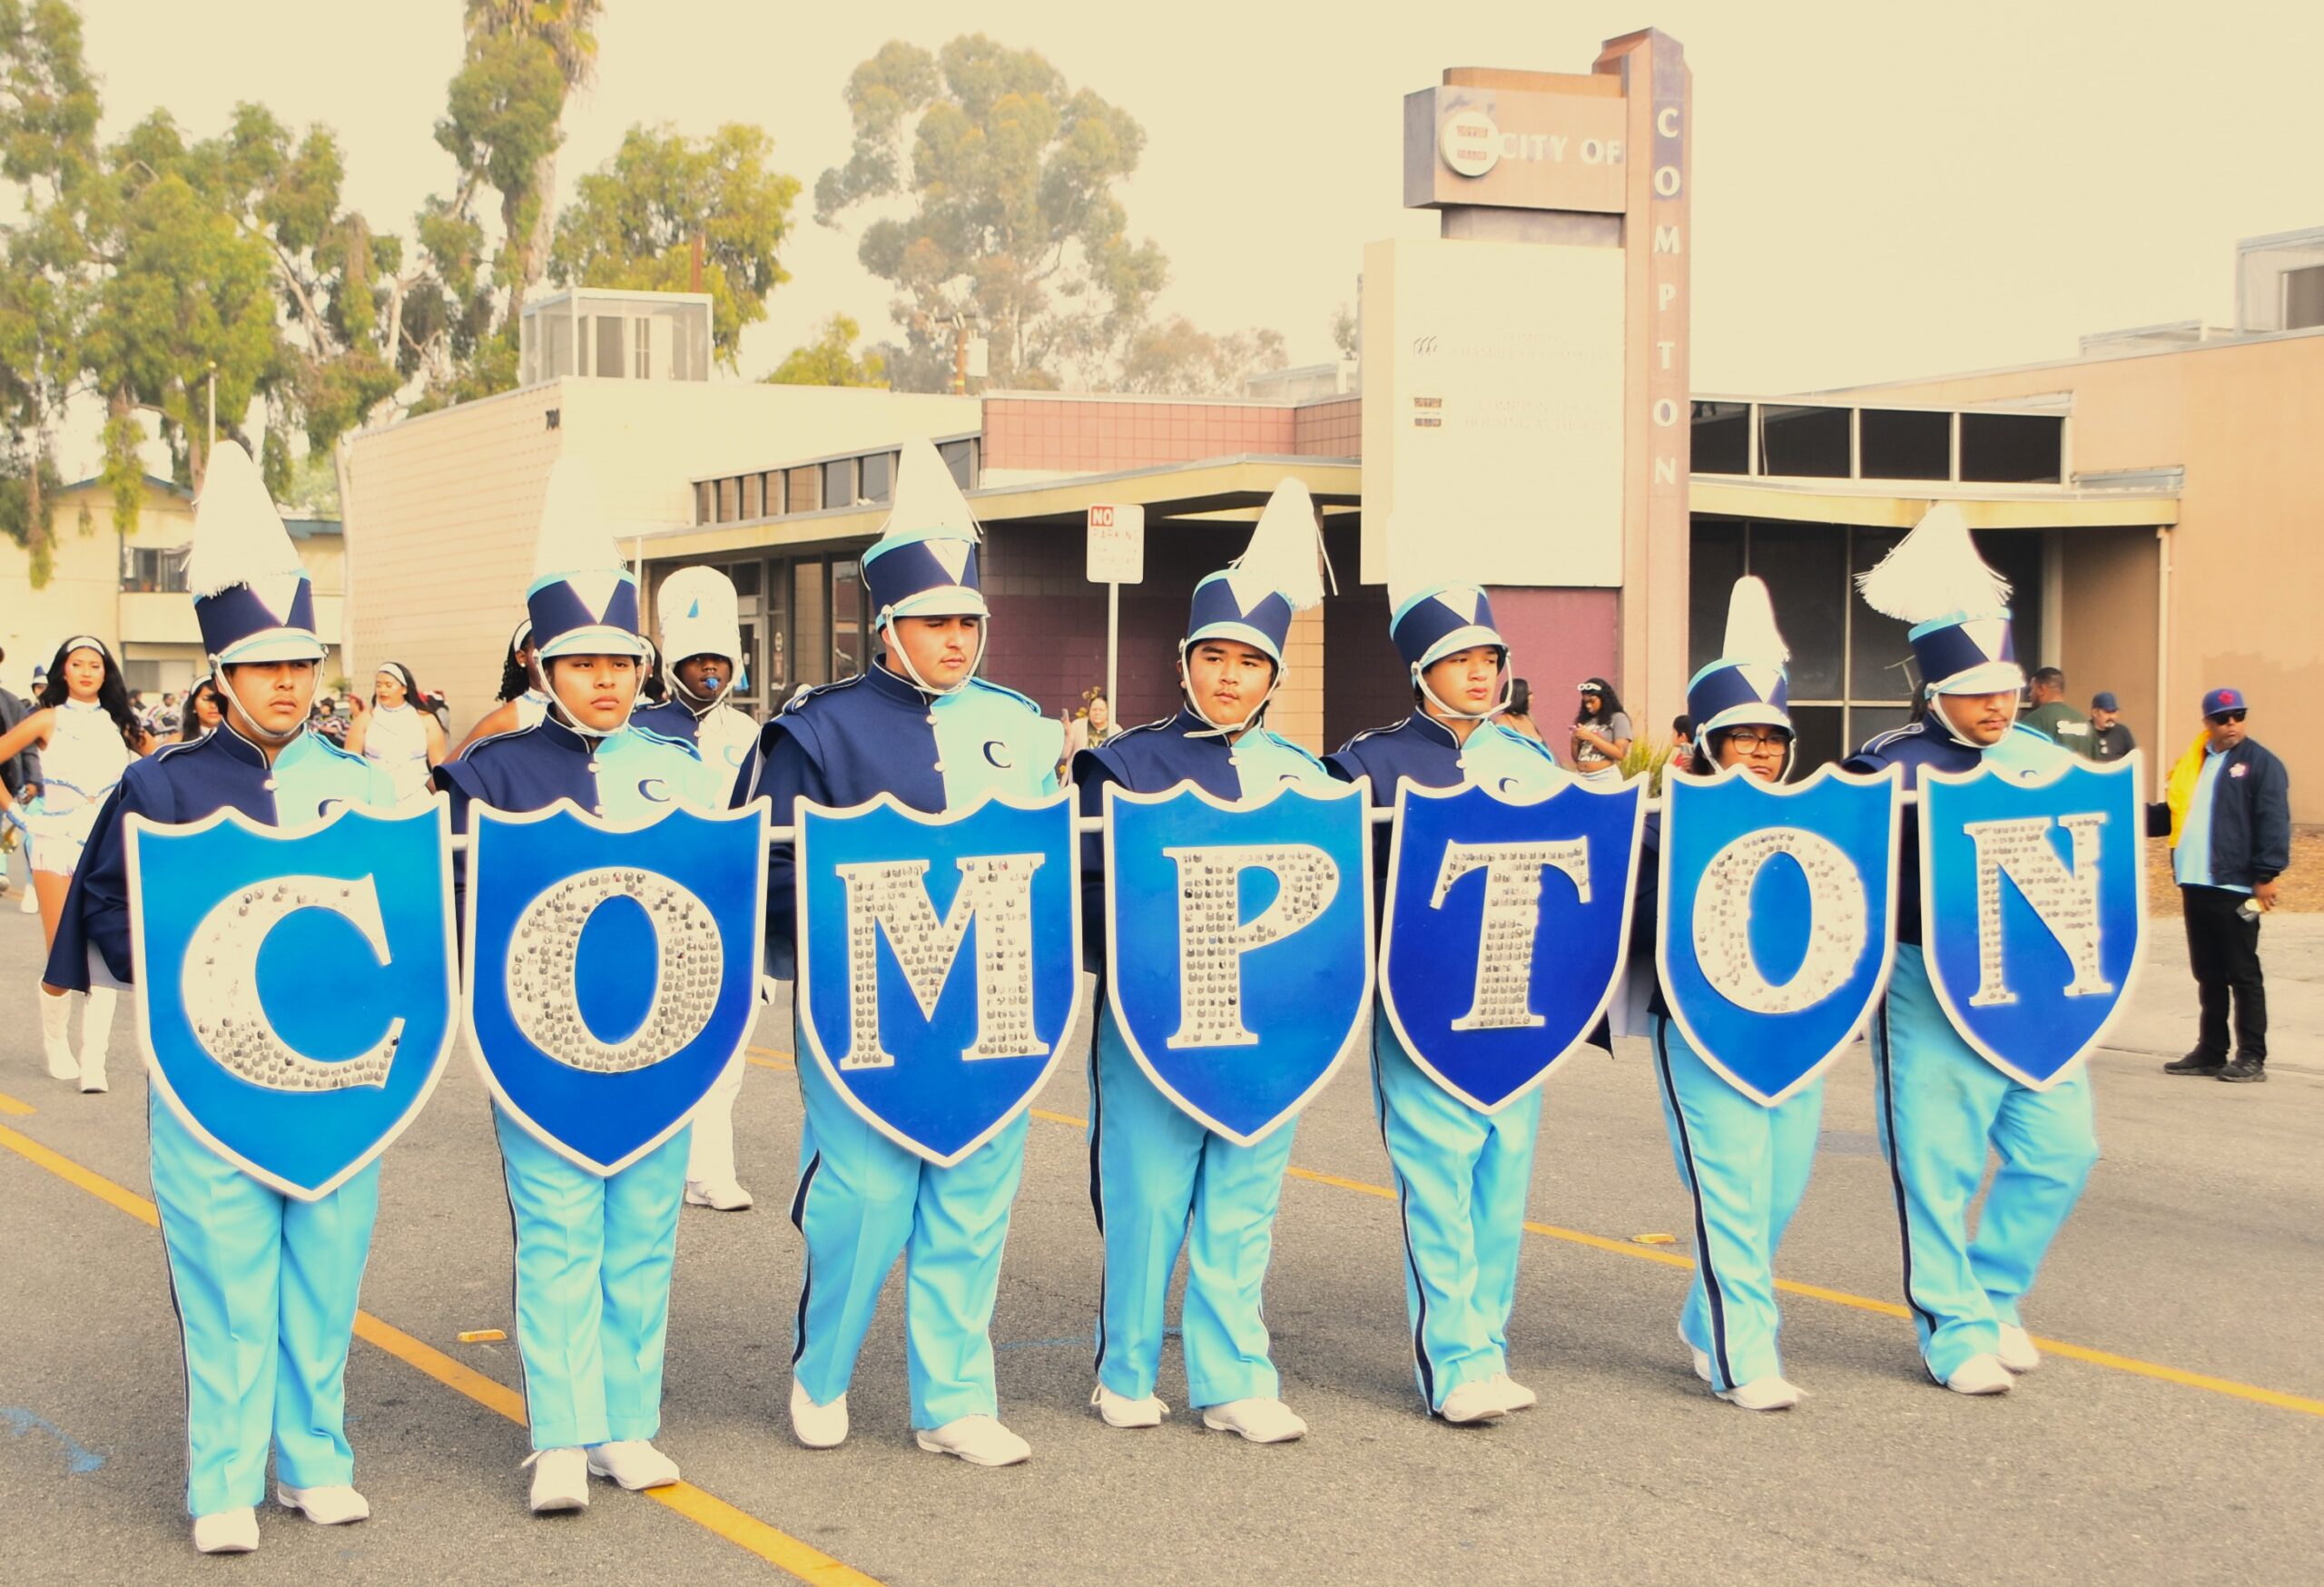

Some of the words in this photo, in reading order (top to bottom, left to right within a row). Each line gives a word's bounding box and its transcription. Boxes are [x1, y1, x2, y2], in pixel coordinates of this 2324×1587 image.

[1499, 133, 1569, 163] CITY
[1581, 138, 1622, 165] OF
[1653, 108, 1681, 485] COMPTON
[1092, 508, 1113, 526] NO
[982, 741, 1012, 769] C
[637, 779, 671, 803] C
